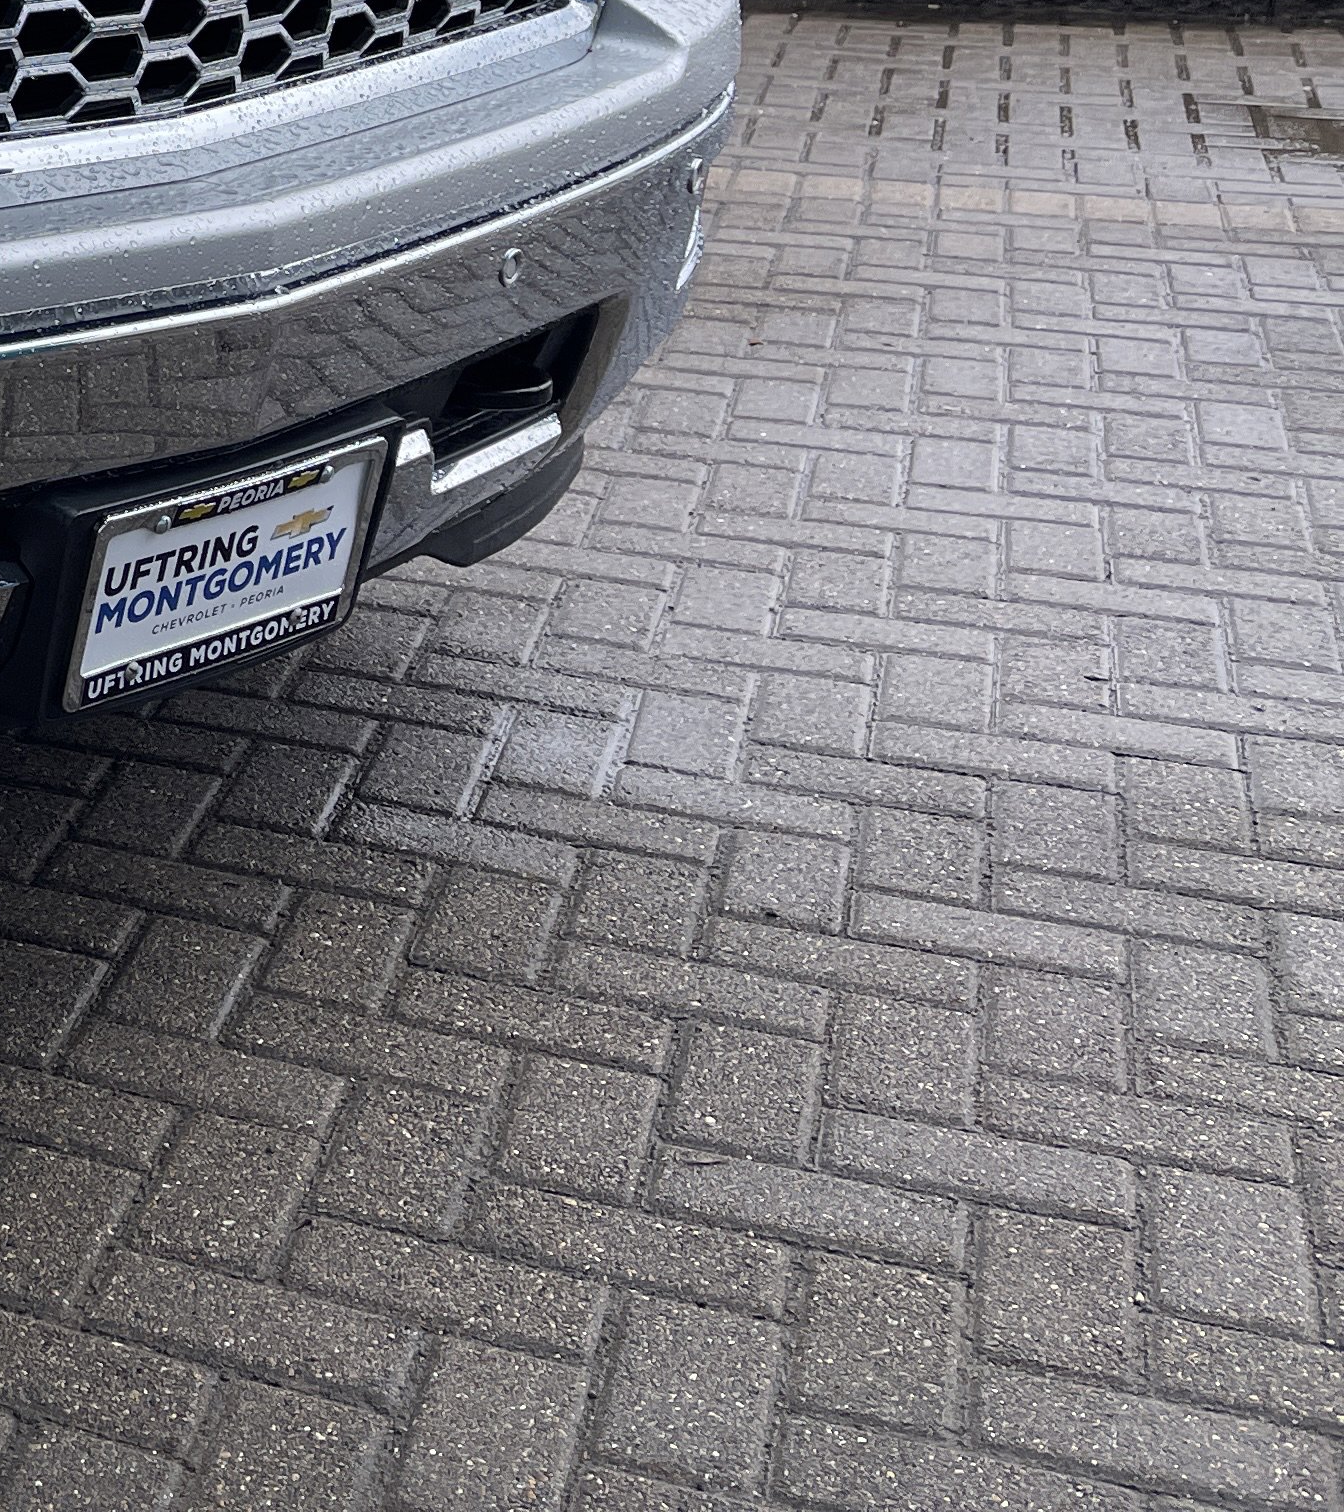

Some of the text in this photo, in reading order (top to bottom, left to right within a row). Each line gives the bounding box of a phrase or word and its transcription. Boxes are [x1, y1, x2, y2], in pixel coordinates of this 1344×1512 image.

[216, 479, 284, 513] PEORIA
[95, 528, 347, 634] MONTGOMERY
[104, 526, 259, 596] UFTRING
[152, 585, 285, 635] CHEVROLET PEORIA
